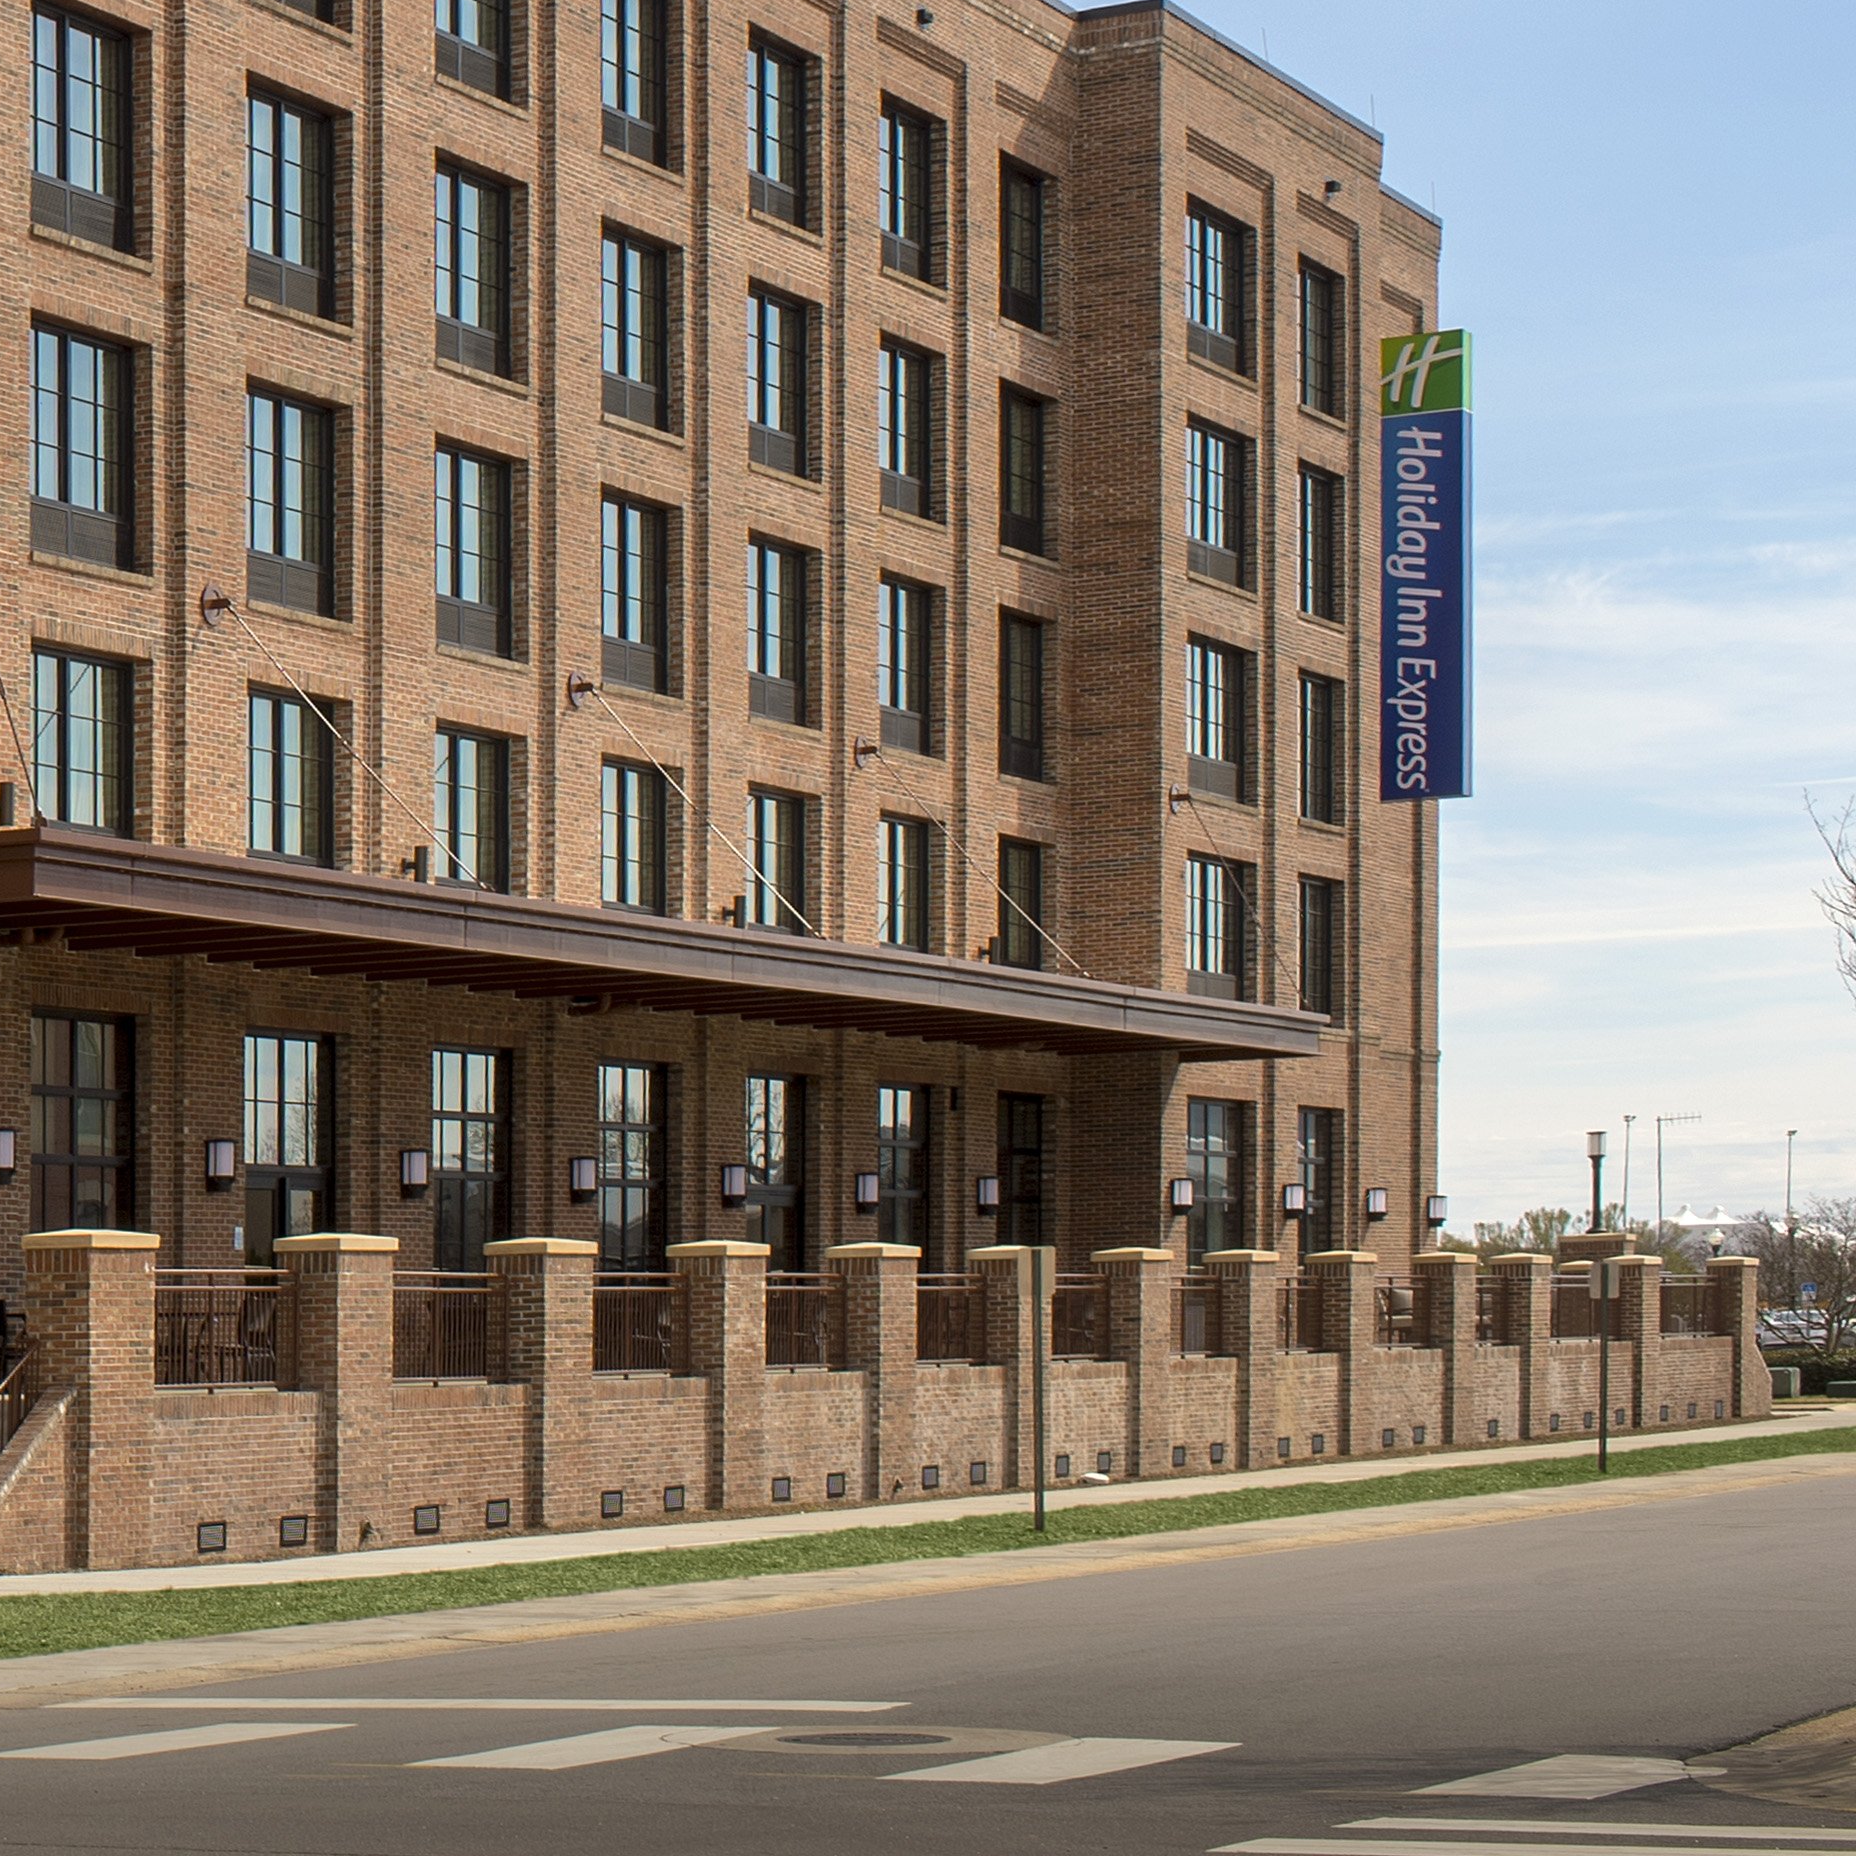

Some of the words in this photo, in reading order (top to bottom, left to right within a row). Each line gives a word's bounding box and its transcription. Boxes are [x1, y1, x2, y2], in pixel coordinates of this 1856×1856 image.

[1386, 425, 1443, 580] Holiday
[1397, 587, 1443, 647] Inn
[1386, 657, 1437, 790] Express
